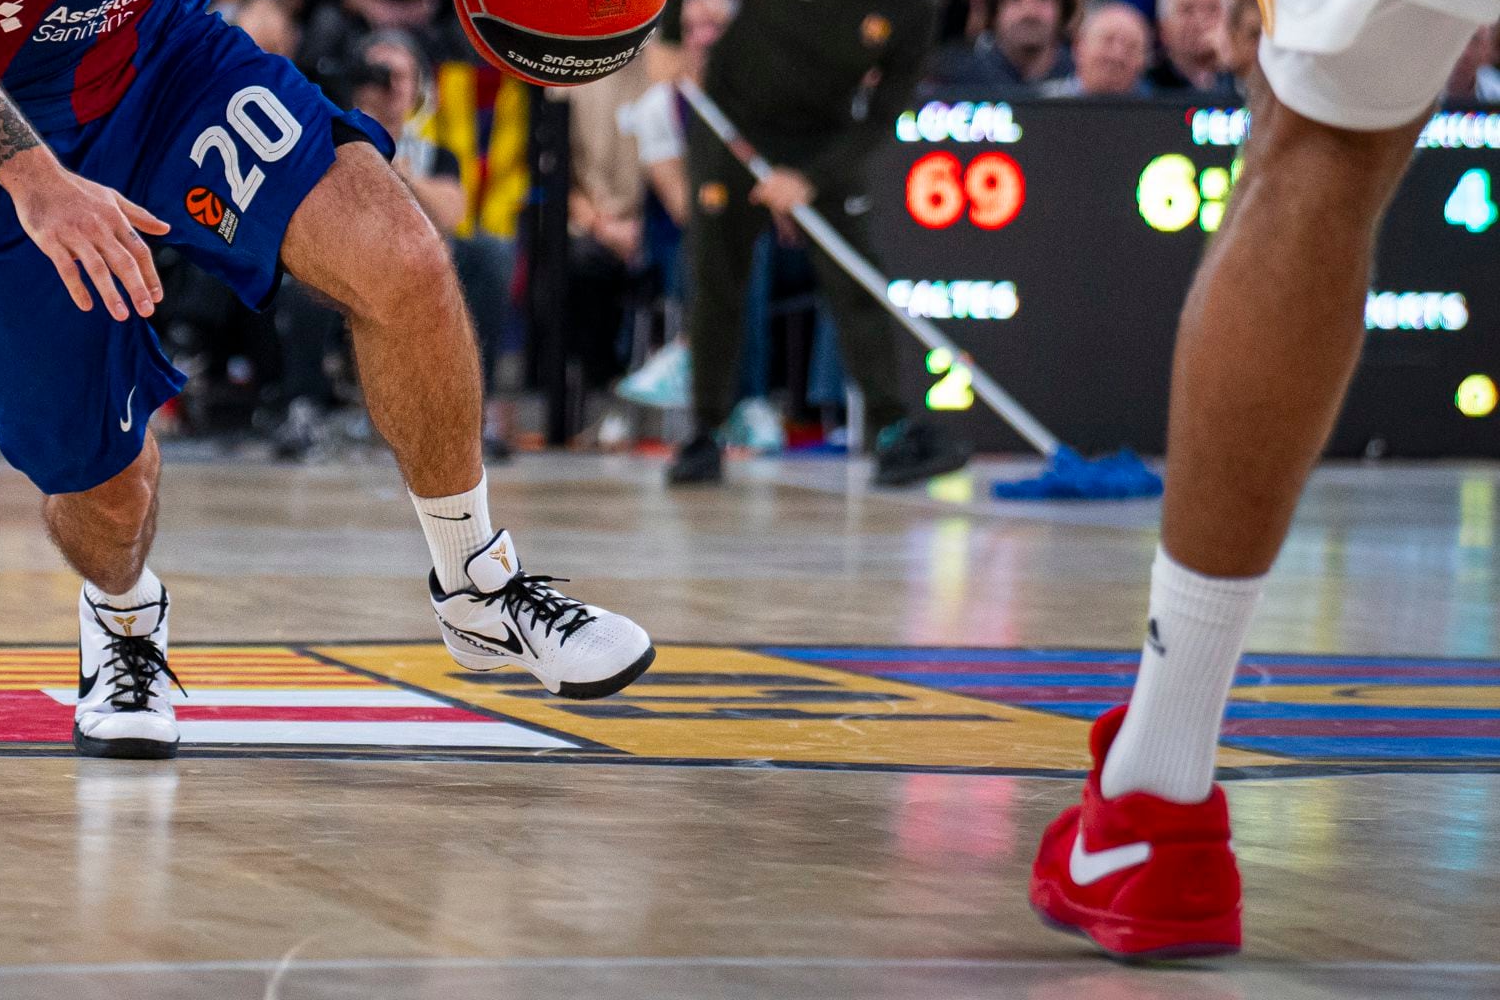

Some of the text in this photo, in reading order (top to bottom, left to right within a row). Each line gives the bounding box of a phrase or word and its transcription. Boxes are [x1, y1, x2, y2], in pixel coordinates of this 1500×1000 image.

[507, 50, 628, 77] TURKISH AIRLINES
[190, 85, 303, 213] 20
[896, 101, 1023, 142] LOCAL
[905, 151, 1026, 230] 69
[1136, 152, 1244, 232] 6:
[925, 347, 974, 411] 2
